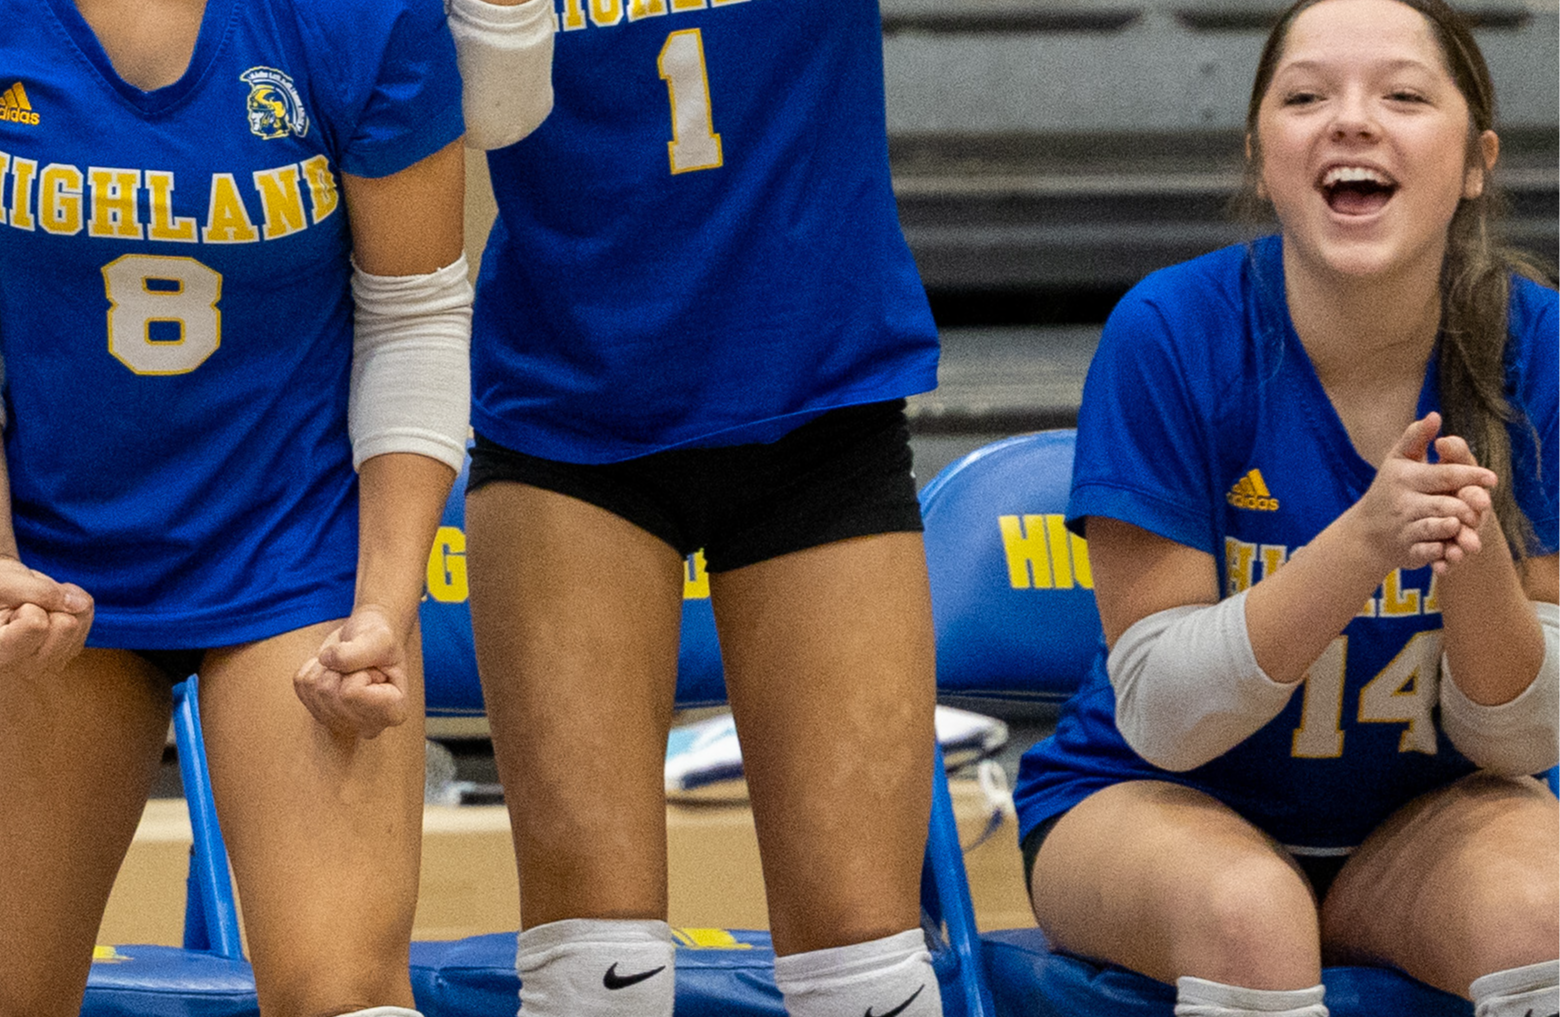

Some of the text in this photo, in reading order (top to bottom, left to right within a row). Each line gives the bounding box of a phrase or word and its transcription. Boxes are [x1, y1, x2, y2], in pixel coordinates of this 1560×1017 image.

[656, 28, 724, 176] 1
[100, 253, 223, 376] 8
[1291, 629, 1442, 759] 14
